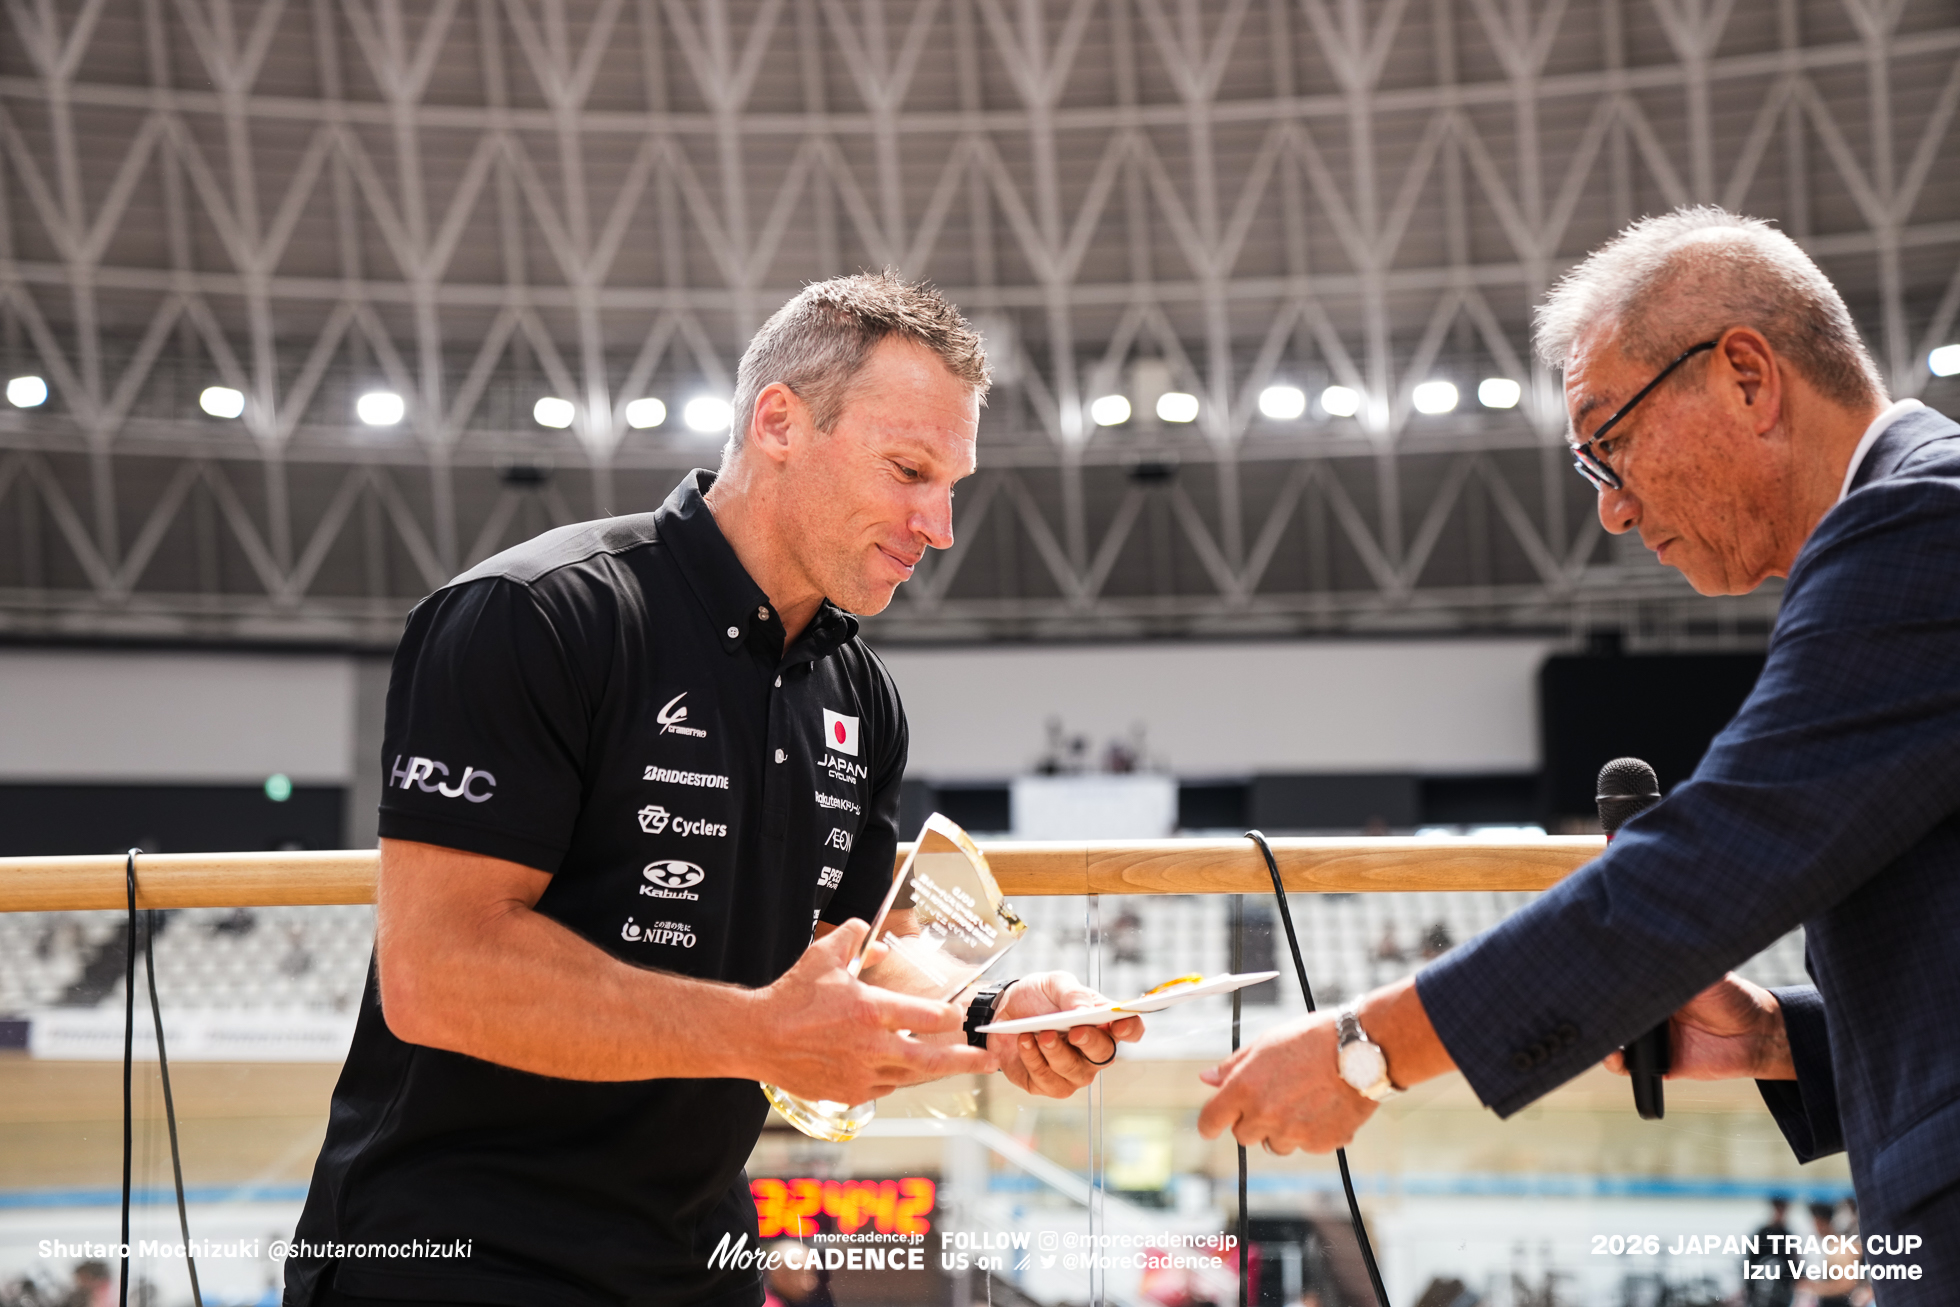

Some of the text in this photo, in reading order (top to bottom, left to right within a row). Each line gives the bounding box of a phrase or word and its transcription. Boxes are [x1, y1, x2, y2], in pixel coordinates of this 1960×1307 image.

[817, 754, 867, 779] JAPAN
[389, 755, 497, 803] HPCJC
[643, 765, 729, 790] BRIDGESTONE
[829, 770, 857, 785] CYCLING
[672, 817, 727, 837] Cyclers
[639, 884, 699, 901] Kabuto
[654, 920, 692, 932] この道の先に
[642, 928, 697, 948] NIPPO
